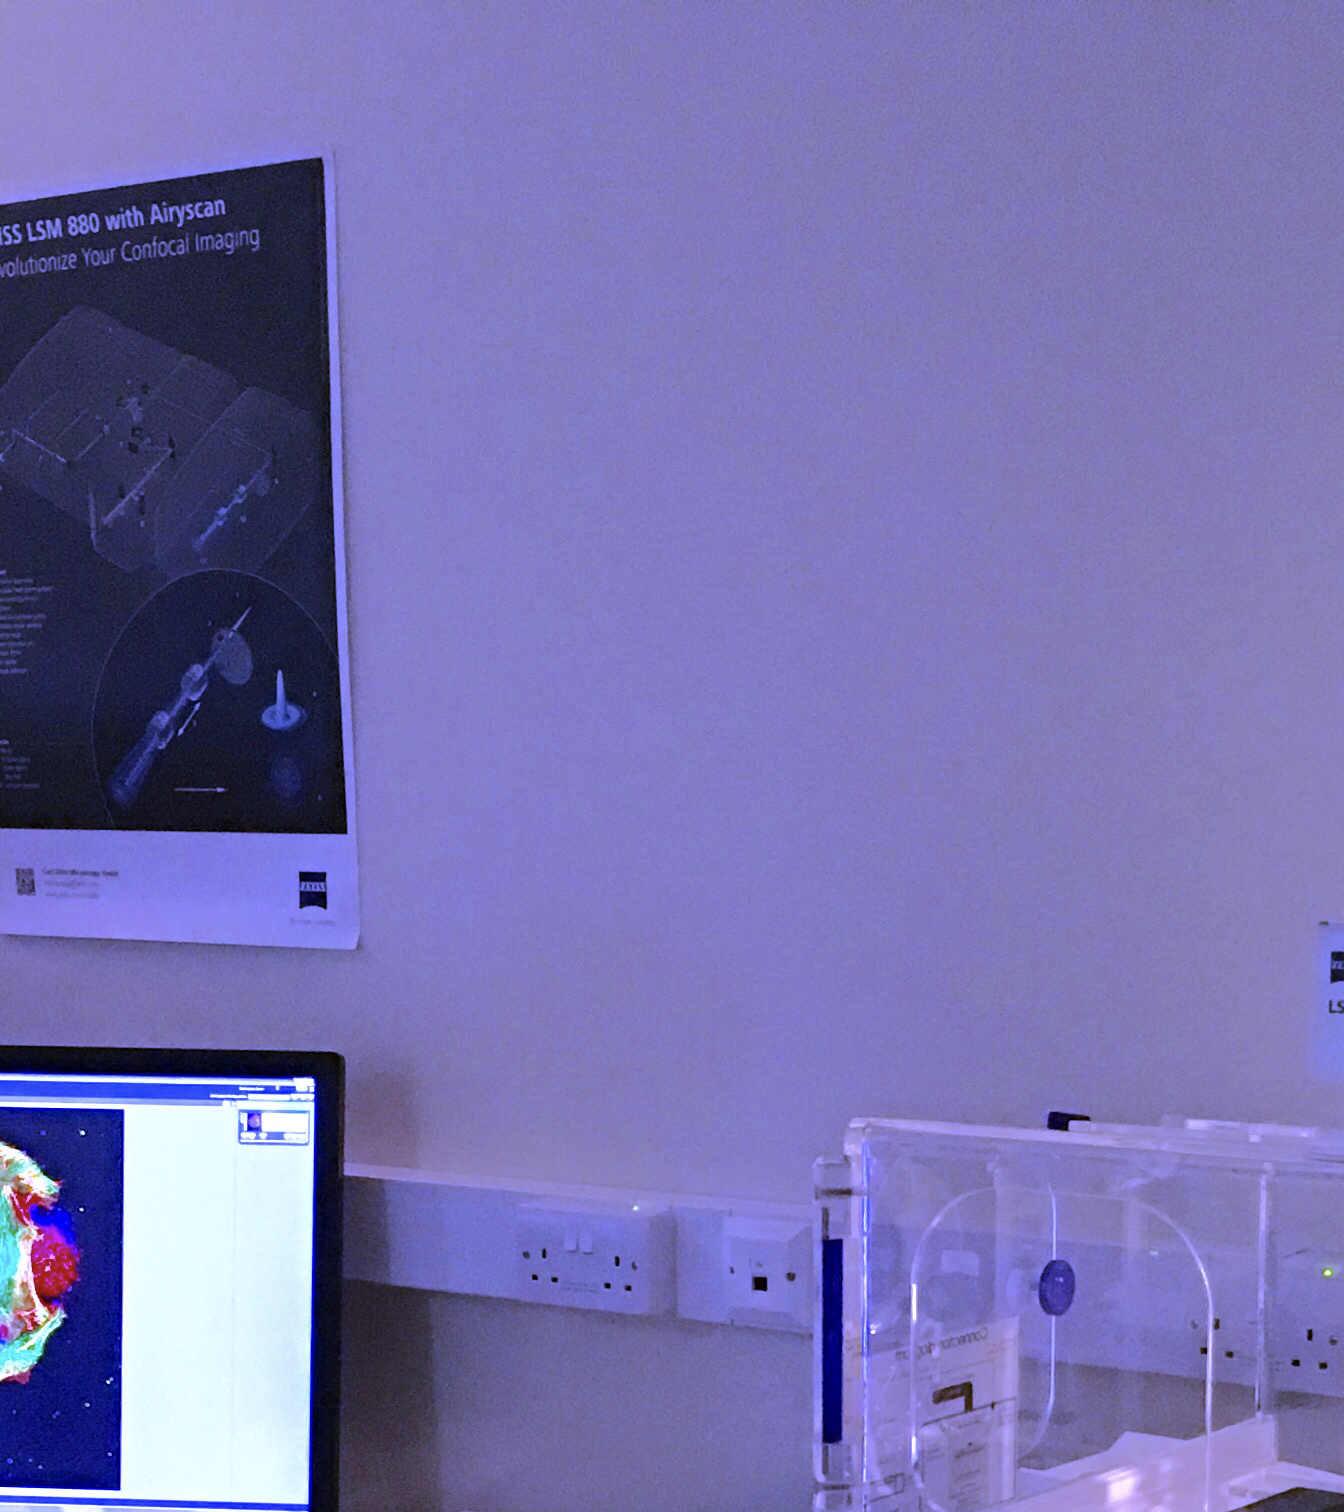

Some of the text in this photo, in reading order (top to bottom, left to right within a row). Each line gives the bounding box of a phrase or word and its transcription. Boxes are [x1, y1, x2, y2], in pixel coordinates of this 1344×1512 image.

[26, 218, 63, 242] LSM
[67, 213, 100, 236] 880
[104, 205, 144, 231] with
[150, 199, 226, 227] Airyscan
[82, 247, 116, 267] Your
[121, 232, 190, 261] Confocal
[195, 229, 260, 255] Imaging
